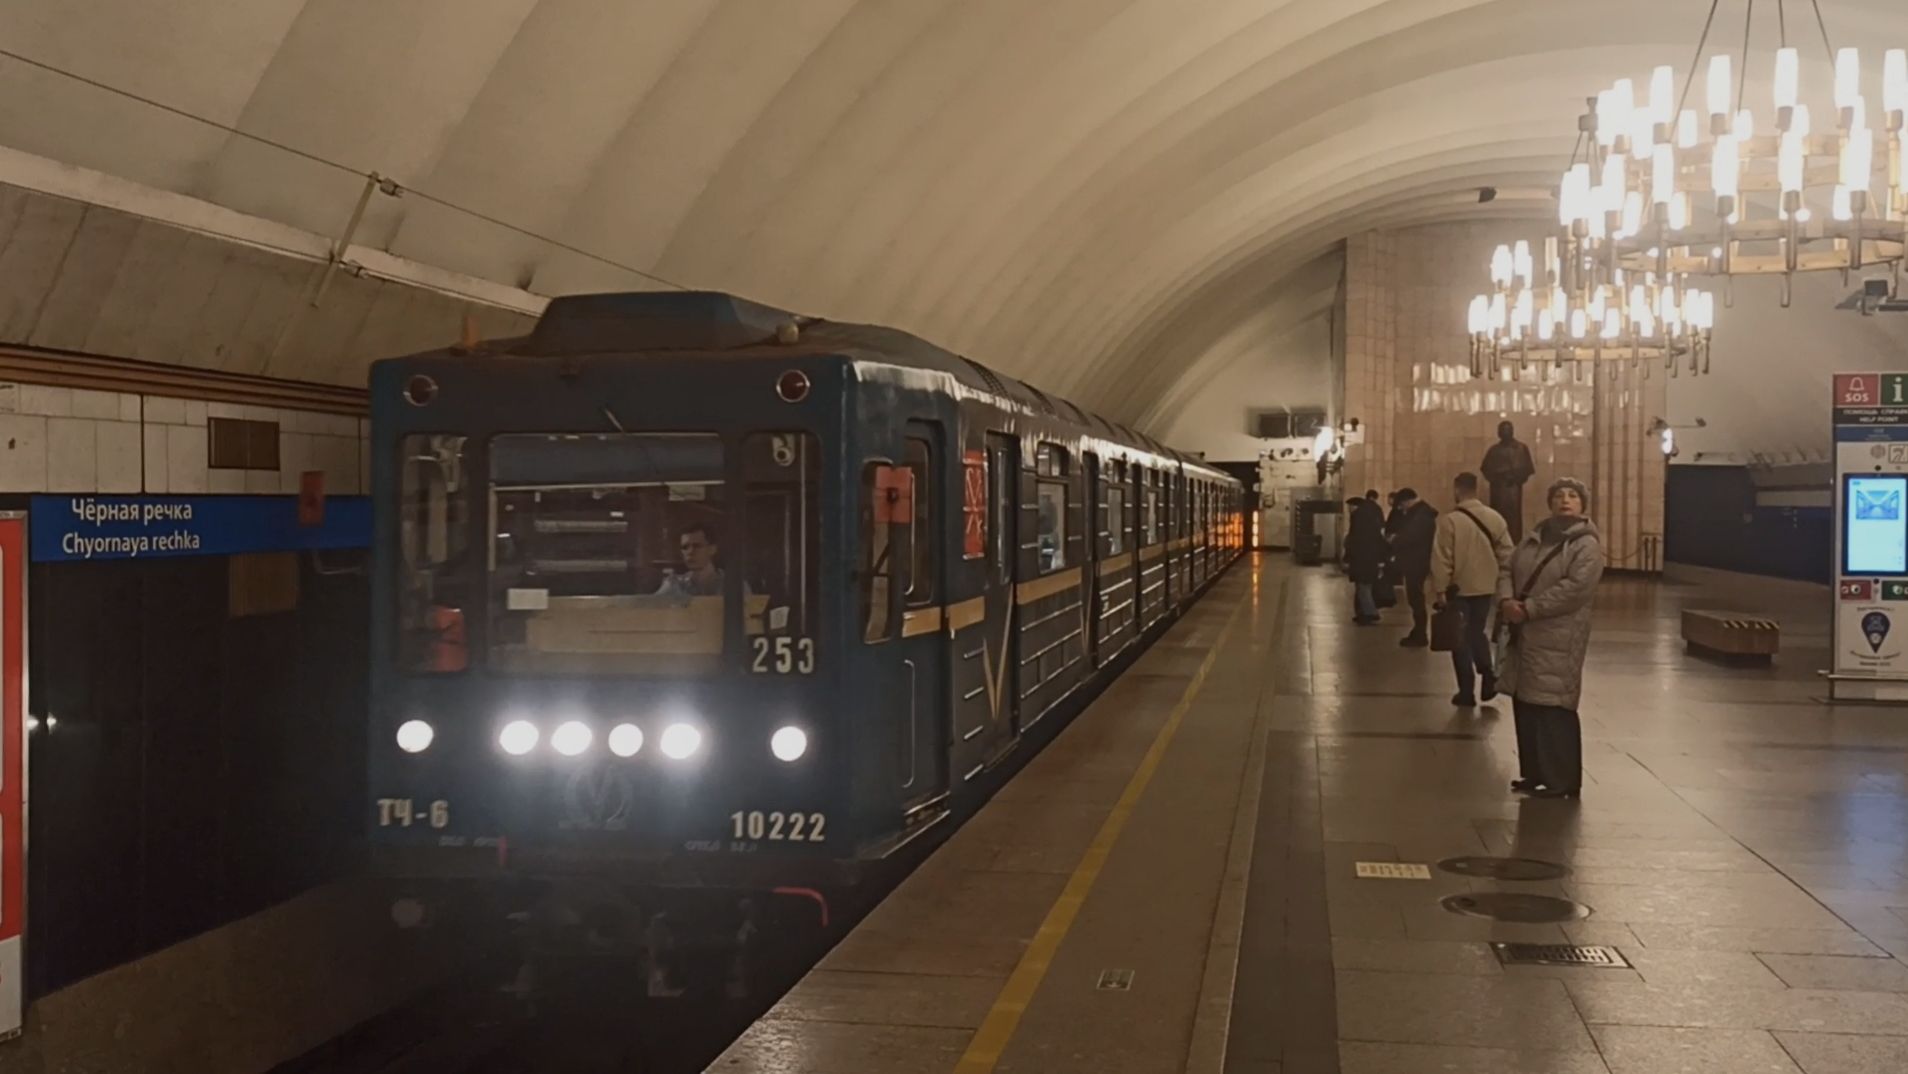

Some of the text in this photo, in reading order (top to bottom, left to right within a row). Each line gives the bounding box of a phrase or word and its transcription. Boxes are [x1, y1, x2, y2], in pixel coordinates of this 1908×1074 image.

[1845, 393, 1869, 403] SOS
[72, 498, 193, 526] Чёрная речка
[62, 530, 200, 558] Chyornaya rechka
[752, 637, 815, 673] 253
[377, 799, 450, 828] ТЧ-6
[731, 810, 826, 842] 10222
